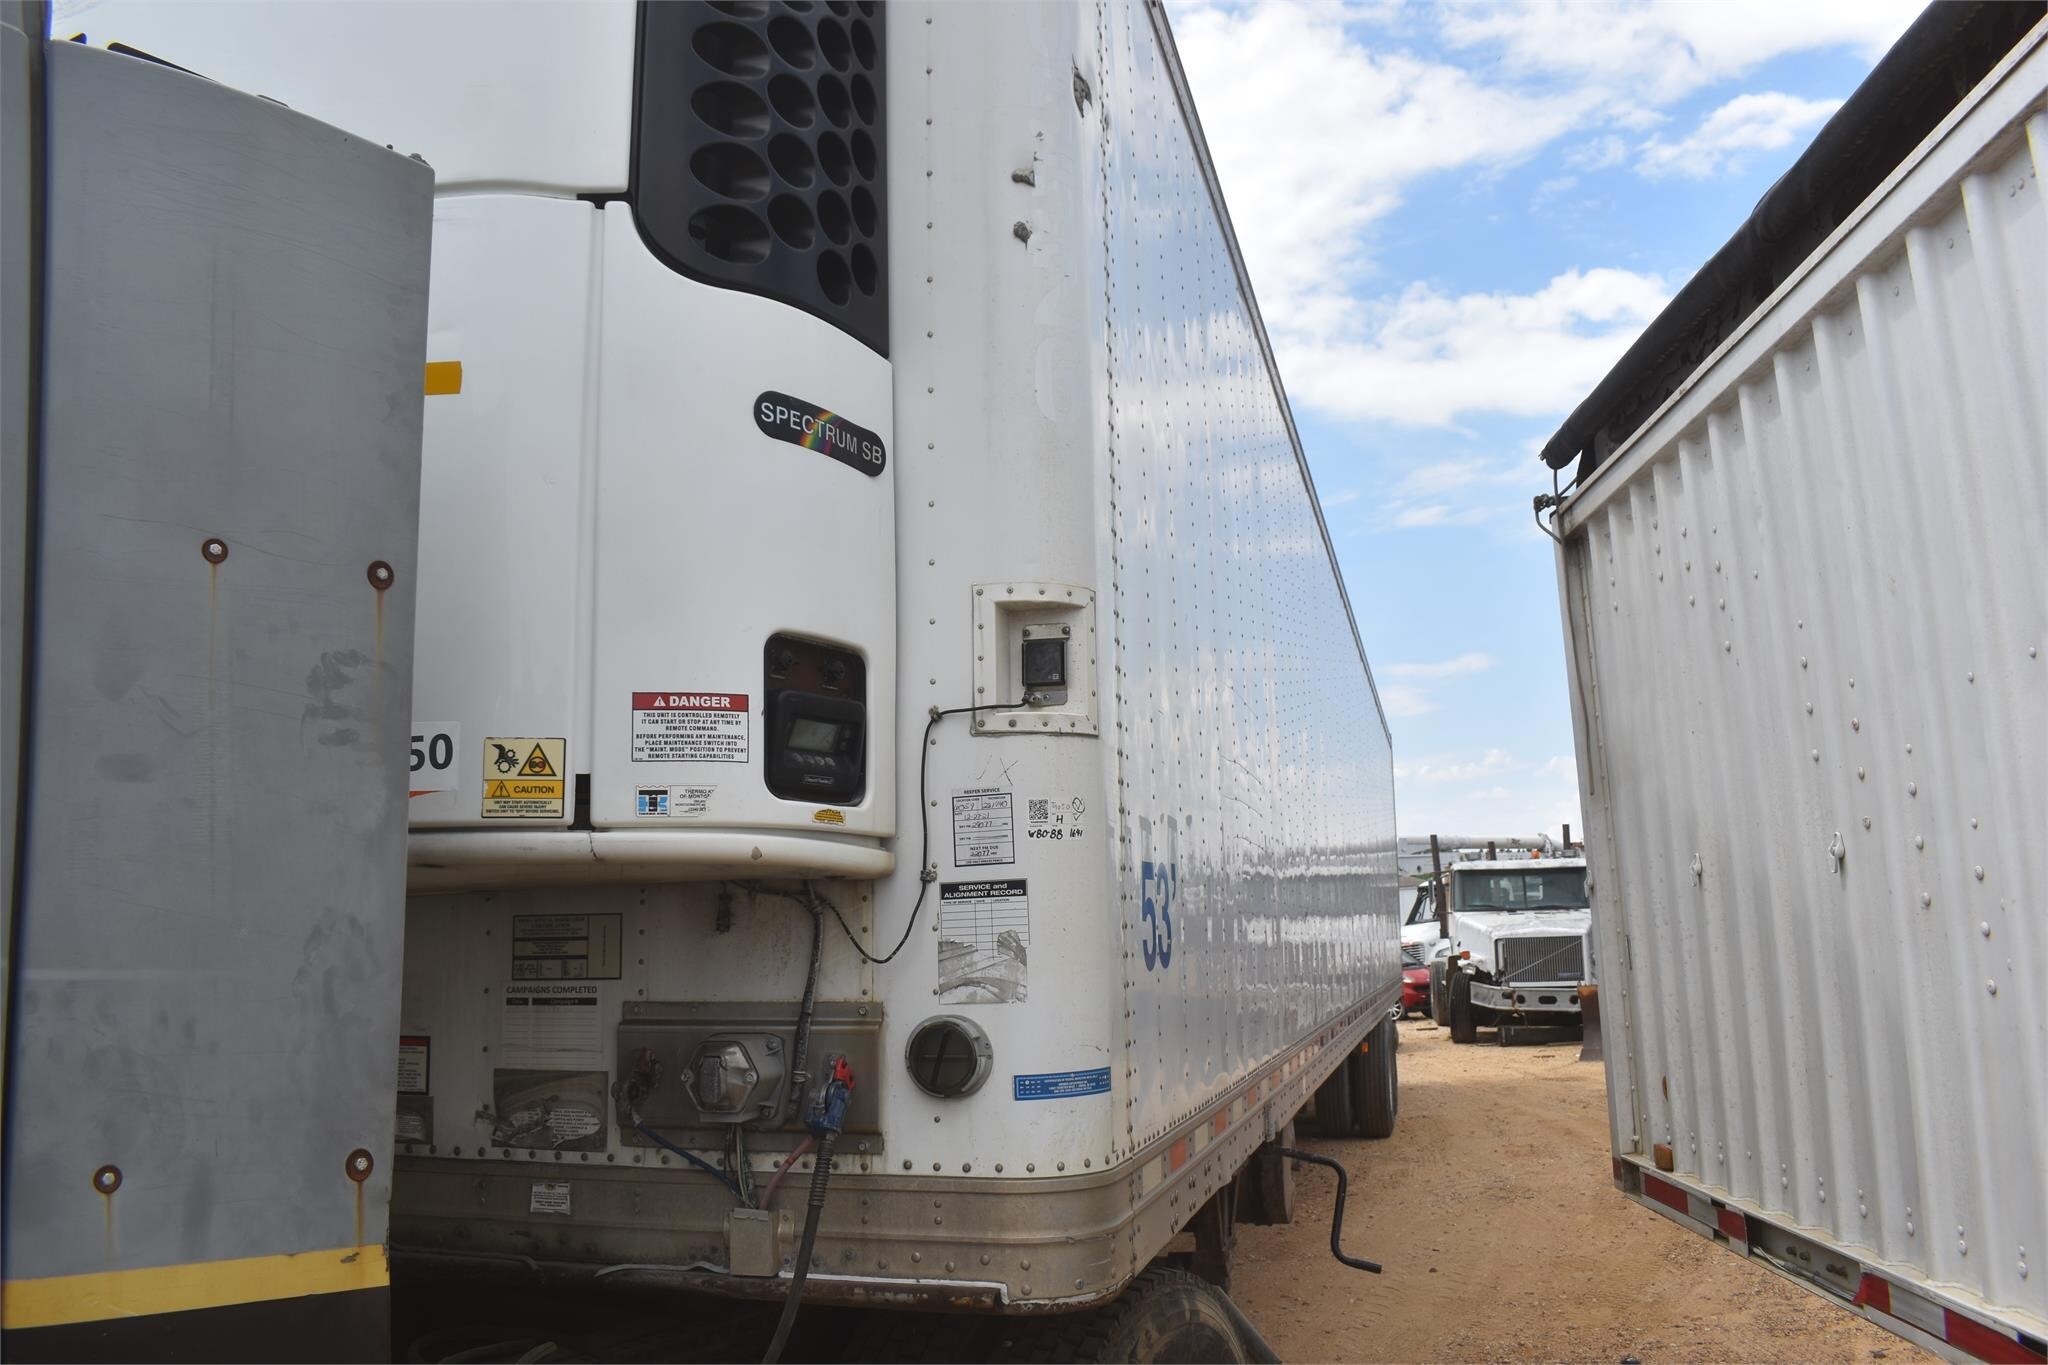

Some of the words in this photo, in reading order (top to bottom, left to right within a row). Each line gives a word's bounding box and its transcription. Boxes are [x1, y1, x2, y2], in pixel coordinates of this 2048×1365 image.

[760, 402, 858, 454] SPECTRUM
[862, 441, 882, 464] SB
[669, 696, 731, 708] DANGER
[513, 785, 555, 794] CAUTION
[1056, 814, 1063, 824] H
[506, 986, 551, 994] CAMPAIGNS
[552, 986, 597, 994] COMPLETED
